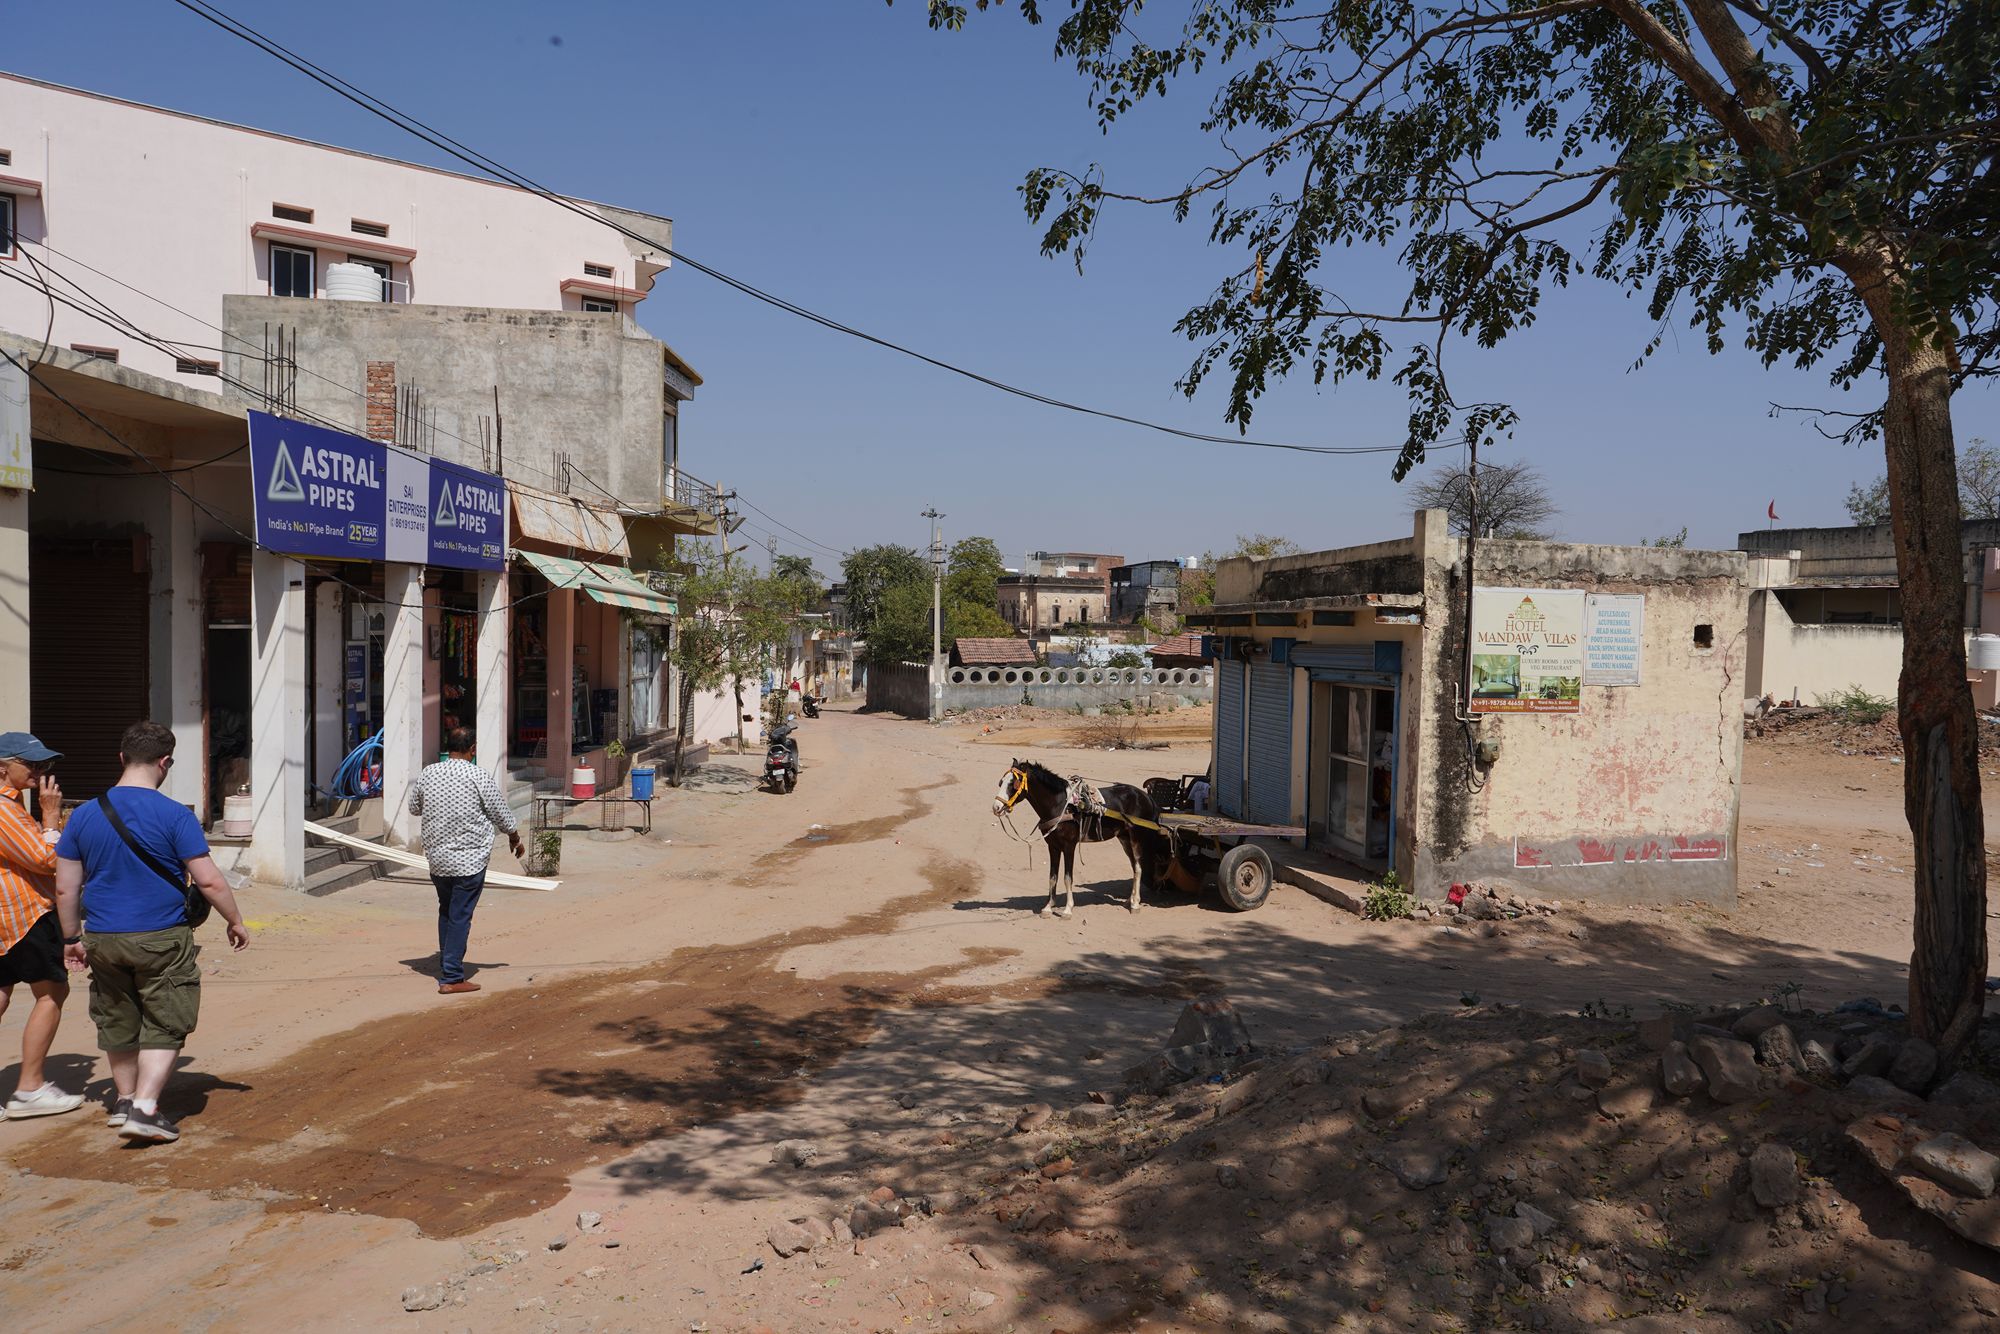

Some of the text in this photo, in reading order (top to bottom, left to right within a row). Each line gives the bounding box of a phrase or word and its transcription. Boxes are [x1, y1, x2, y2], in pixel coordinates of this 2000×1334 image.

[301, 445, 380, 489] ASTRAL
[309, 483, 355, 512] PIPES
[403, 484, 414, 499] SAI
[455, 483, 501, 516] ASTRAL
[388, 499, 427, 519] ENTERPRISES
[268, 517, 344, 538] India's No.1 Pipe Brand
[459, 512, 487, 534] PIPES
[349, 524, 378, 541] 25 YEAR
[434, 540, 448, 550] India's
[458, 543, 468, 554] Pipe
[467, 544, 480, 554] Brand
[482, 543, 491, 557] 25
[490, 545, 501, 555] YEAR
[1505, 620, 1547, 632] HOTEL
[1478, 631, 1577, 645] MANDAW VILAS
